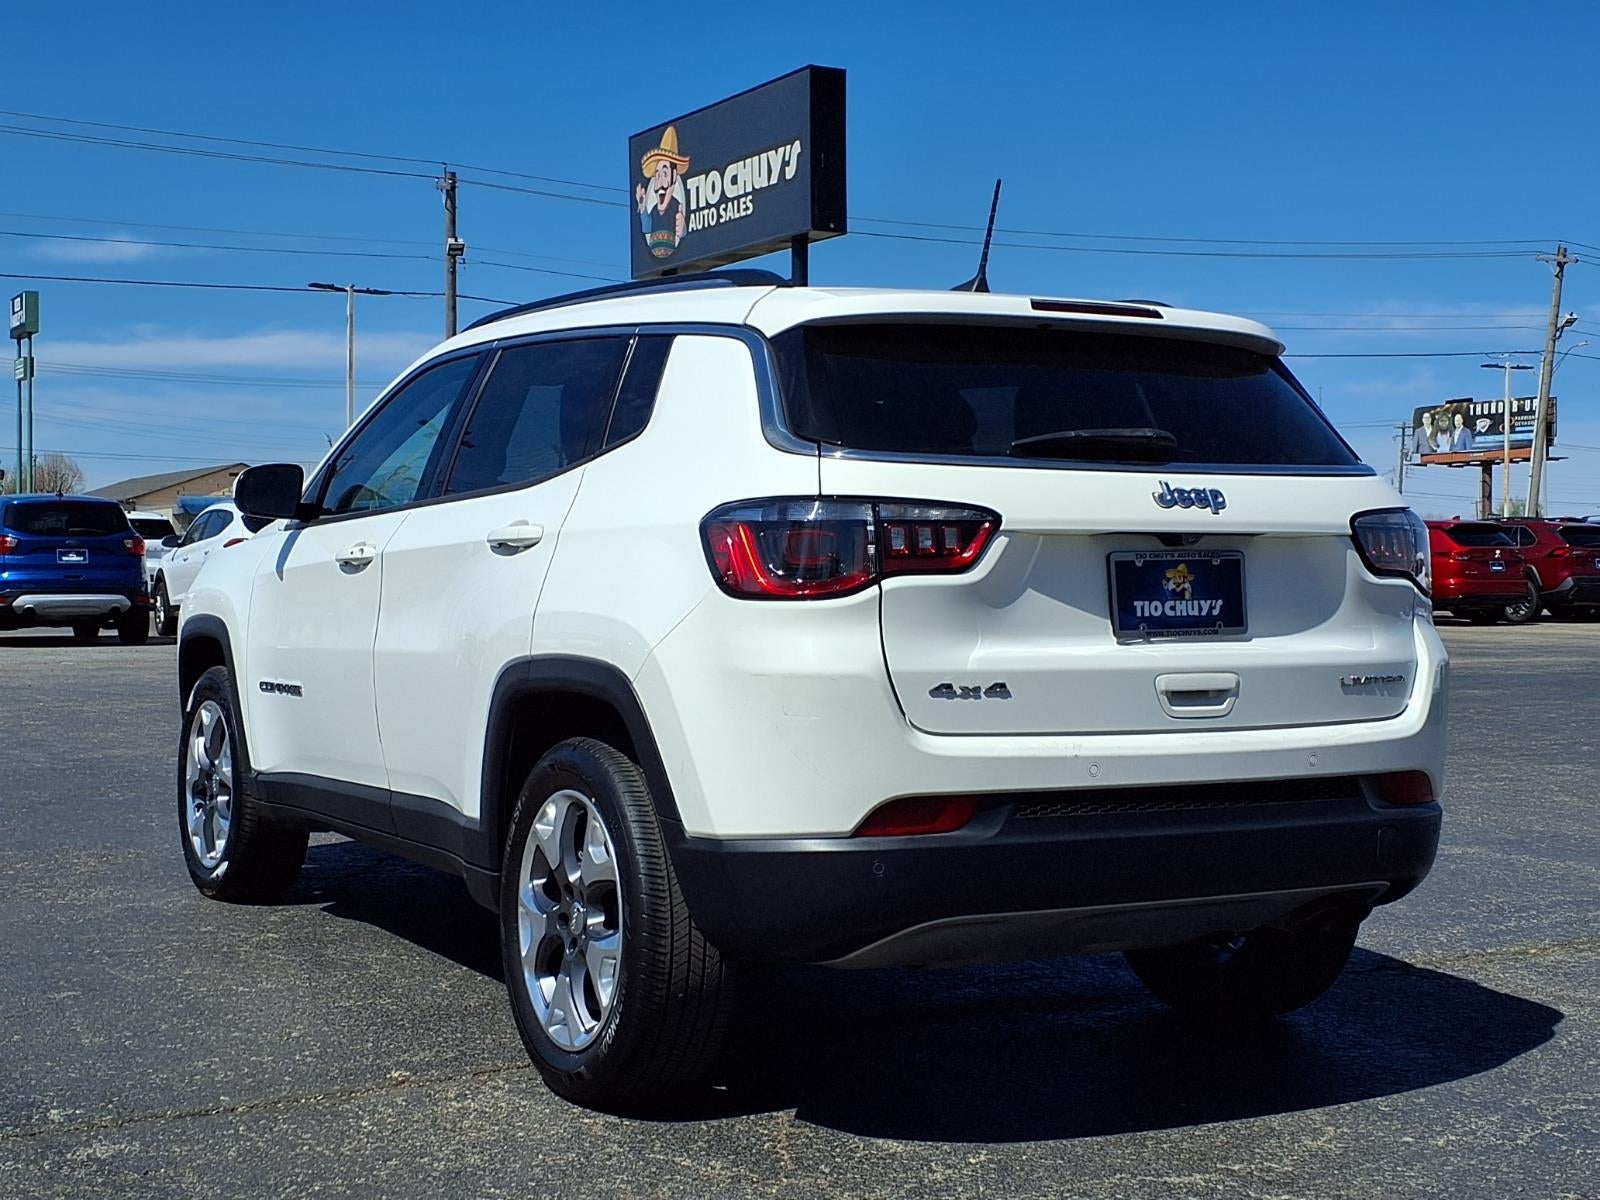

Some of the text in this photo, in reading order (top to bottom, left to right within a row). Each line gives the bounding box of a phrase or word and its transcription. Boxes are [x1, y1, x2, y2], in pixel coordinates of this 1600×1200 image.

[686, 140, 801, 210] TIO CHUY'S
[688, 195, 753, 232] AUTO SALES
[1469, 401, 1517, 416] THUNDR
[1152, 480, 1227, 515] Jeep
[1133, 599, 1223, 617] TIO CHUY'S
